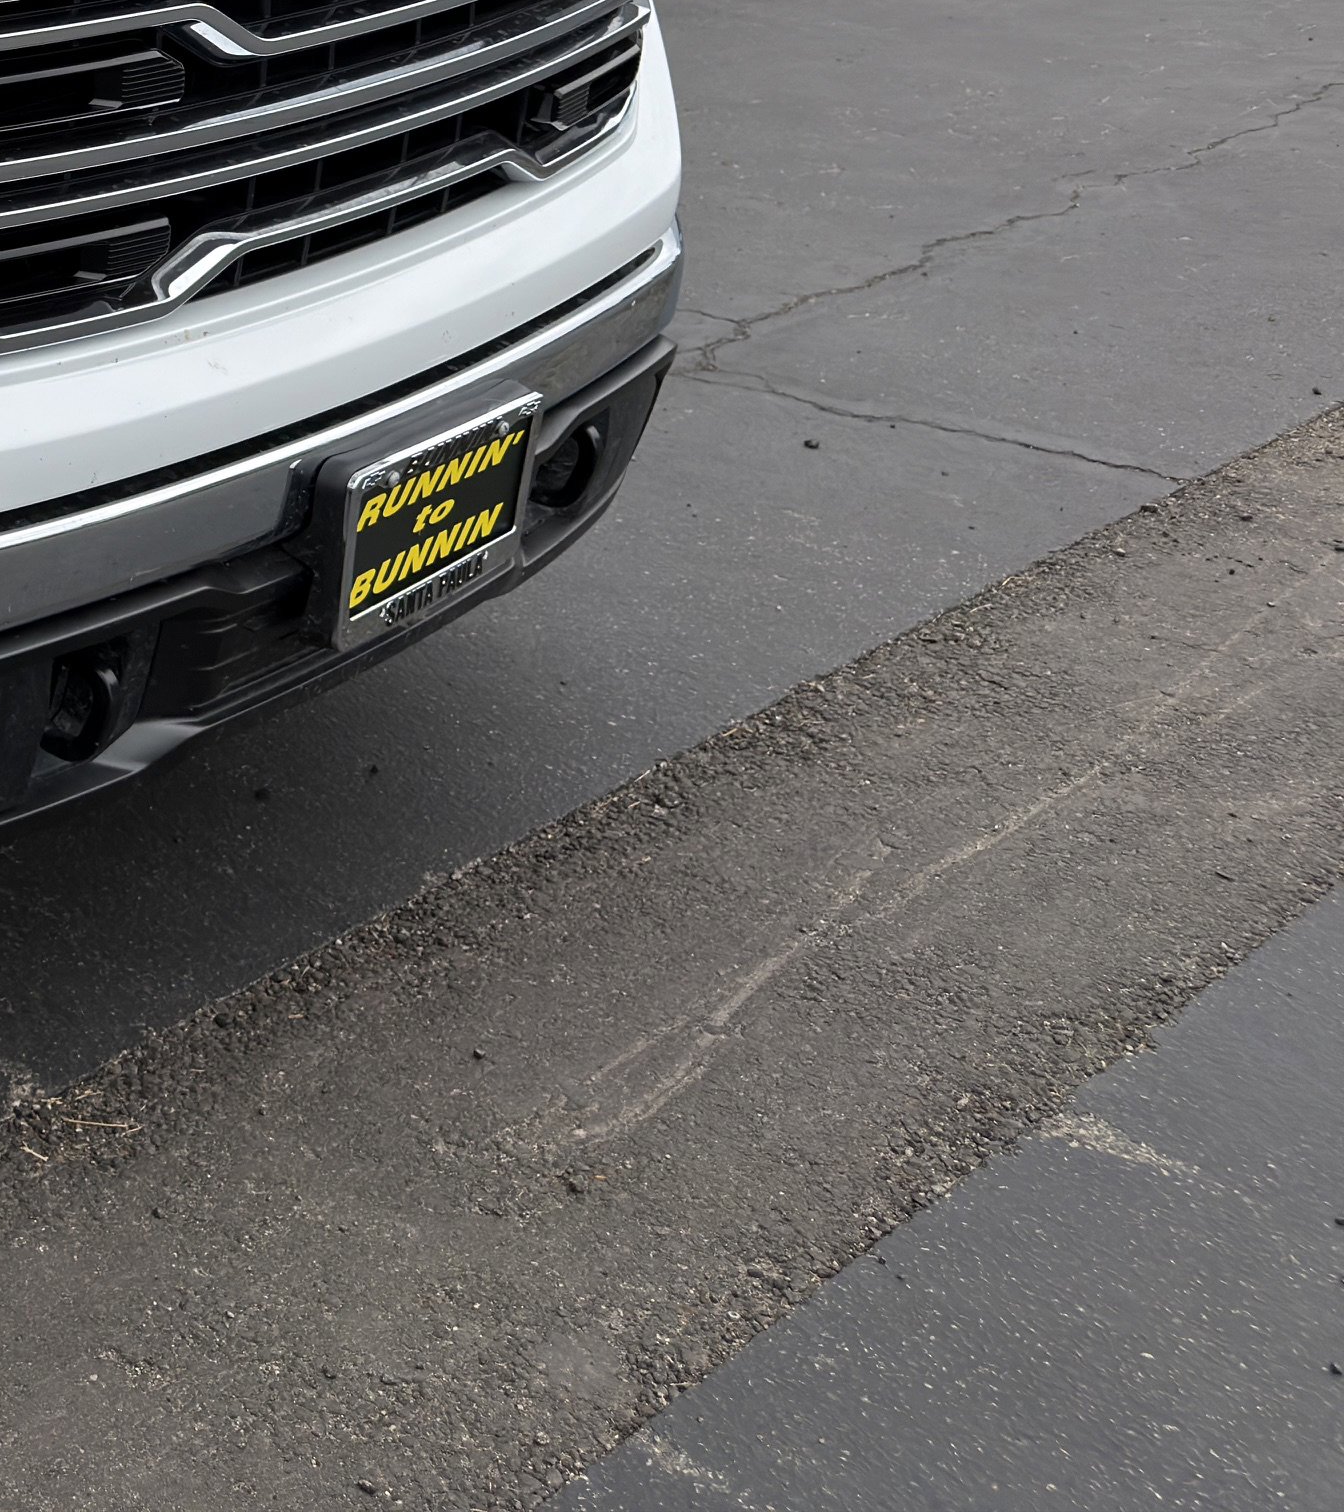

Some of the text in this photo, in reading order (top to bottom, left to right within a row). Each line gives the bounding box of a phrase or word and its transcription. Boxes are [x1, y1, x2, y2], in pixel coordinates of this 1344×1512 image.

[356, 429, 525, 533] RUNNIN'
[412, 498, 455, 534] to
[349, 502, 504, 609] BUNNIN
[383, 553, 485, 626] SANTA PAULA
